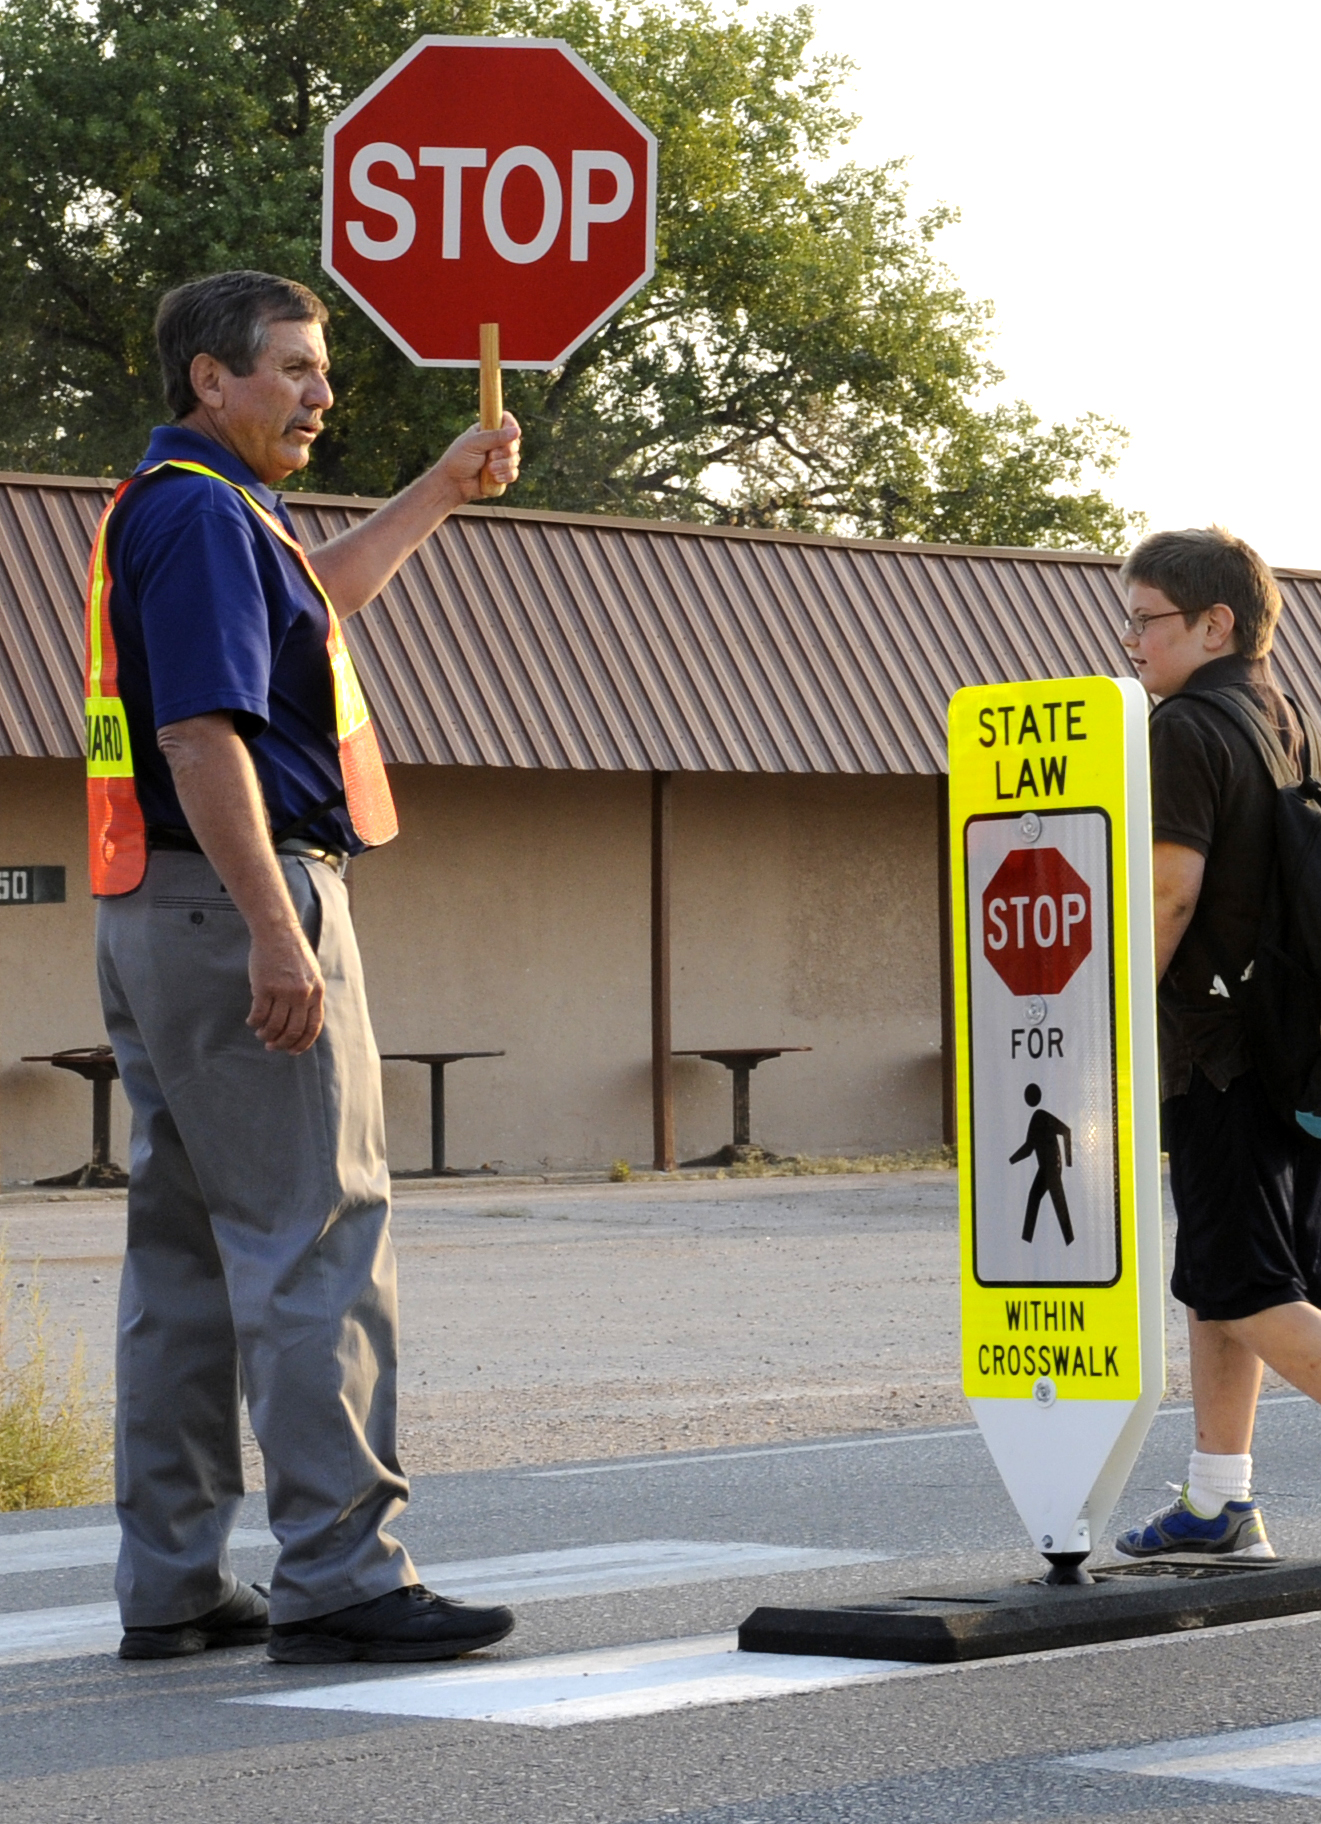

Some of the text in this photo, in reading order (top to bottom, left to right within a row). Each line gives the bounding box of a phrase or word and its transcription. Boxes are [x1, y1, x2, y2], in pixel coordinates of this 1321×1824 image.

[345, 142, 635, 265] STOP
[978, 700, 1087, 748] STATE
[995, 755, 1068, 801] LAW
[987, 892, 1087, 951] STOP
[1010, 1027, 1065, 1060] FOR
[1005, 1300, 1085, 1332] WITHIN
[978, 1344, 1120, 1377] CROSSWALK
